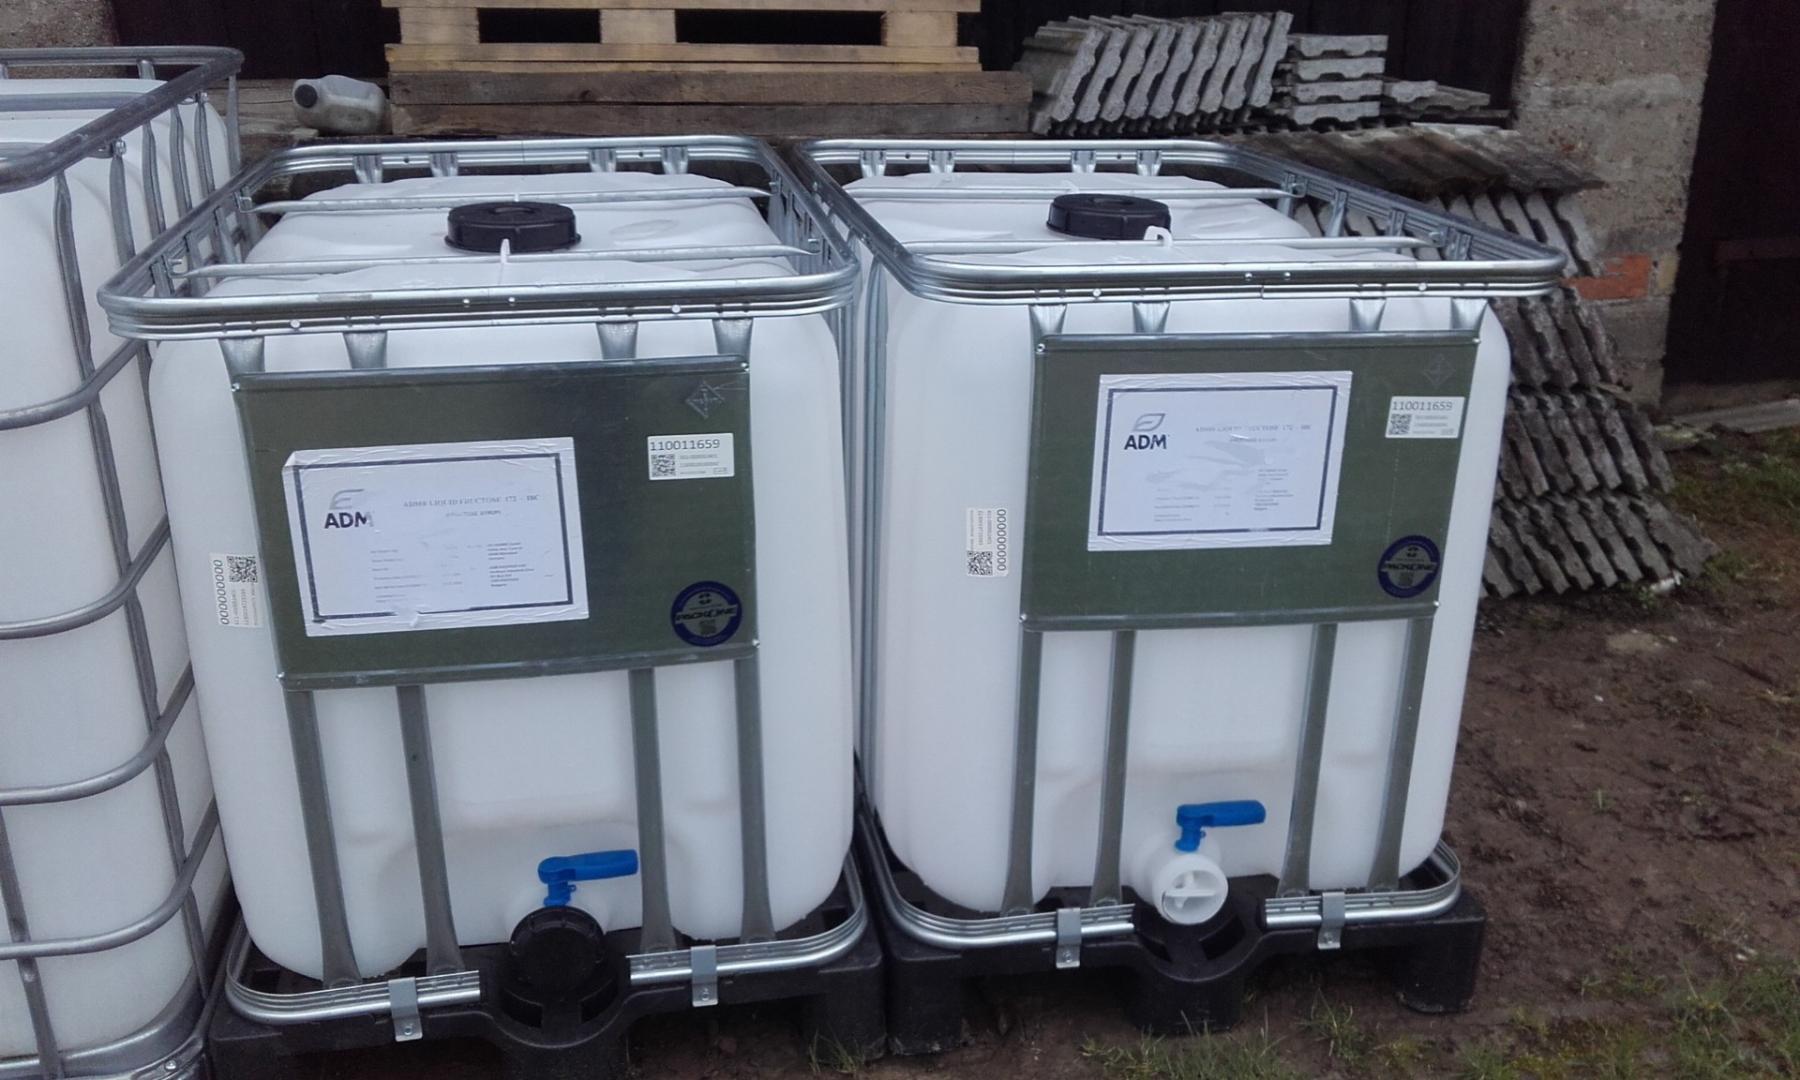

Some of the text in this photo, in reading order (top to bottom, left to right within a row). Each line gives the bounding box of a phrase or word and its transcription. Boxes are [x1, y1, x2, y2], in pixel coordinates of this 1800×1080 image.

[1392, 401, 1453, 411] 110011659
[650, 439, 720, 451] 110011659
[1124, 434, 1167, 450] ADM
[324, 512, 374, 529] ADM
[997, 509, 1007, 571] 000000000
[213, 559, 229, 625] 000000000
